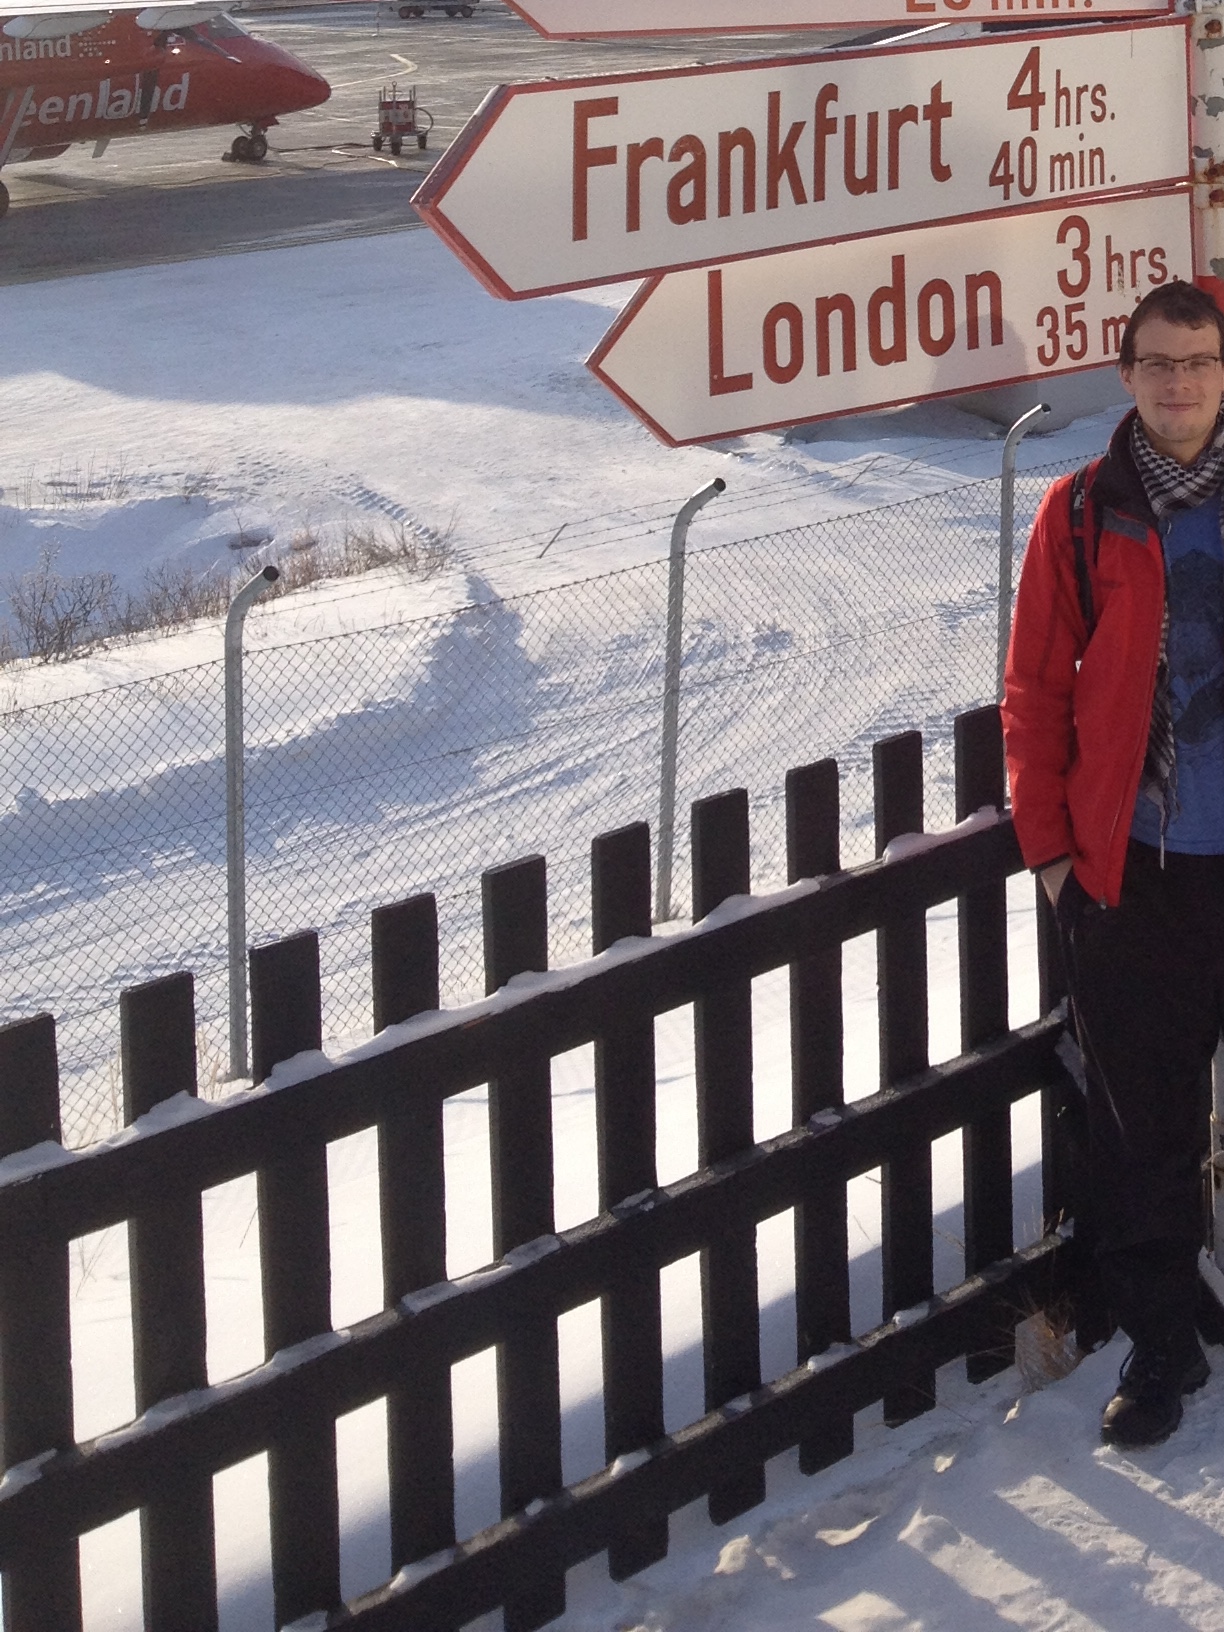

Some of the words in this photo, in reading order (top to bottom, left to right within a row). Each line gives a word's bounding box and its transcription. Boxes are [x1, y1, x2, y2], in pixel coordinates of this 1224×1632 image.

[571, 81, 954, 243] Frankfurt
[1006, 45, 1047, 132] 4
[1054, 69, 1117, 129] hrs.
[988, 136, 1039, 201] 40
[1048, 133, 1118, 193] min.
[707, 254, 1007, 398] London
[1056, 214, 1092, 299] 3
[1105, 234, 1180, 293] hrs.
[1036, 301, 1089, 367] 35
